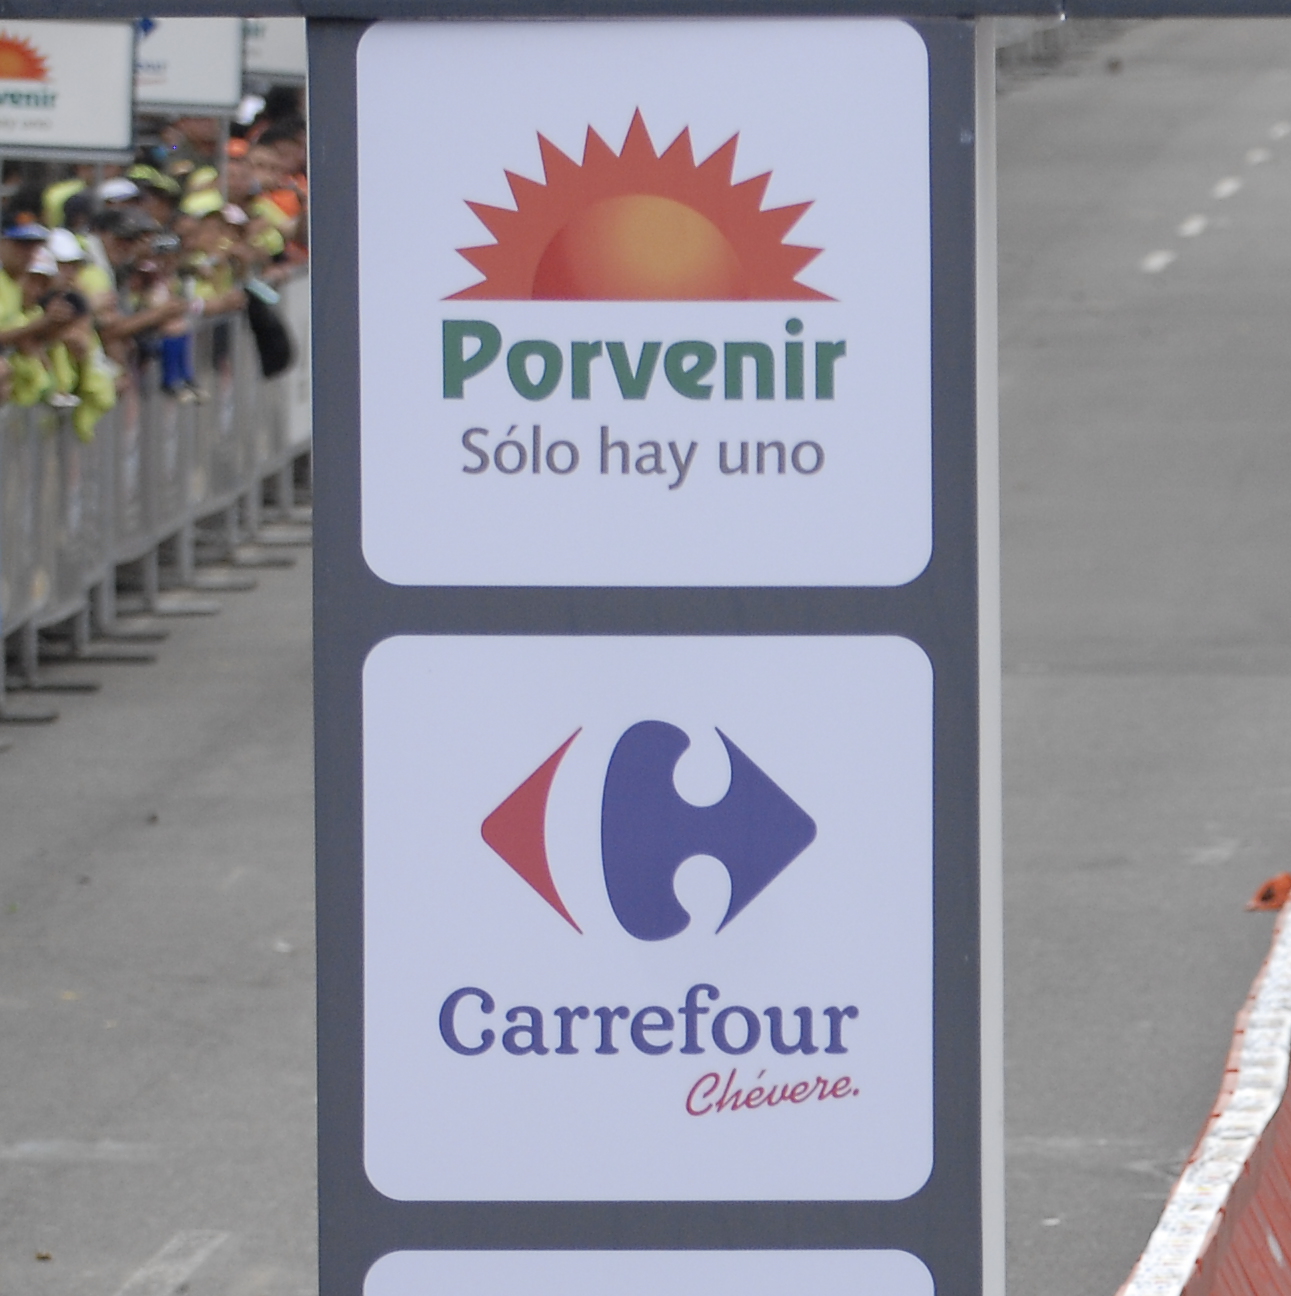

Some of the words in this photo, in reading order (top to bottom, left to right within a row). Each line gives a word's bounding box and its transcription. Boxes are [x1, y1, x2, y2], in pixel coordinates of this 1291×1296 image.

[441, 317, 847, 402] Porvenir
[461, 424, 580, 475] Sólo
[599, 425, 698, 491] hay
[718, 440, 825, 476] uno
[438, 983, 859, 1057] Carrefour
[685, 1068, 860, 1117] Chévere.
